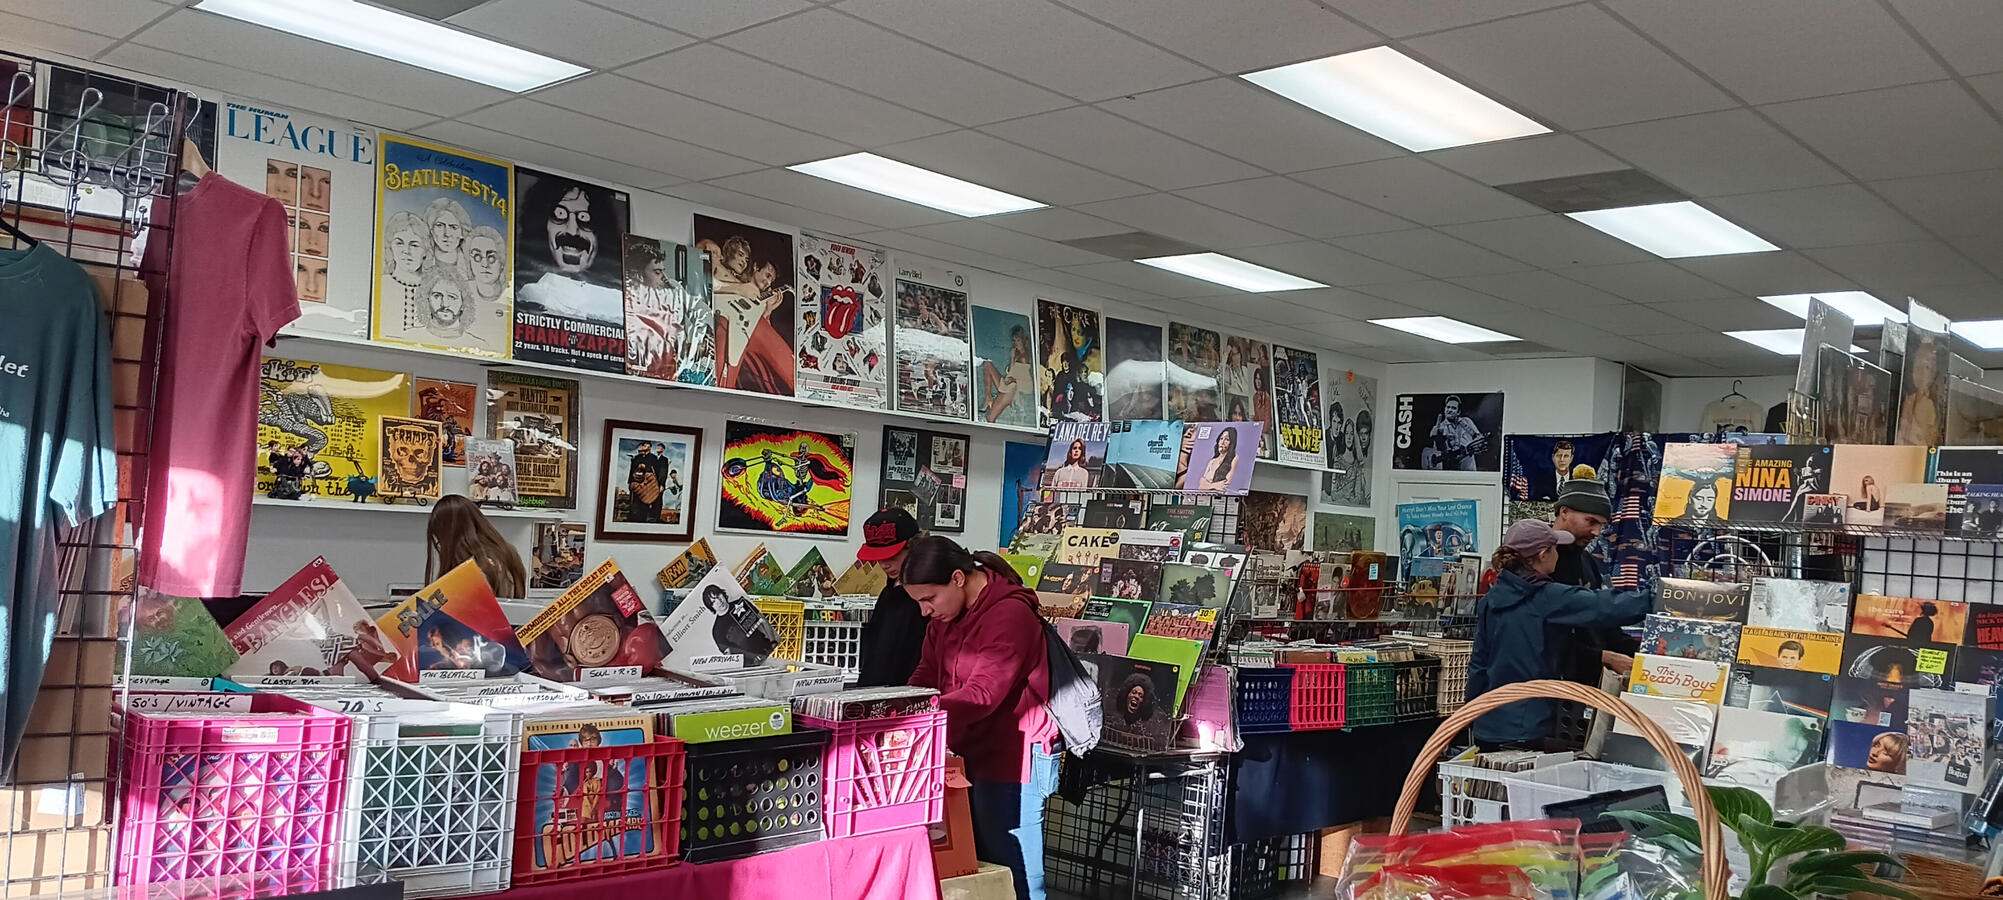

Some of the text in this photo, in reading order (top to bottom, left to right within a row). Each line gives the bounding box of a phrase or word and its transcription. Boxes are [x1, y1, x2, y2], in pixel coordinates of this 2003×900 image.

[226, 102, 289, 119] THE HUMAN
[226, 108, 373, 165] LEAGUE
[516, 312, 561, 329] STRICTLY
[515, 323, 570, 346] FRANK
[520, 388, 548, 403] WANTED
[1397, 396, 1414, 449] CASH
[393, 429, 434, 447] CRAMPS
[1053, 422, 1110, 441] LANA DEL REY
[1755, 460, 1792, 468] AMAZING
[1736, 467, 1791, 489] NINA
[1734, 488, 1791, 502] SIMONE
[1068, 535, 1111, 548] CAKE
[667, 561, 686, 581] RAM
[517, 560, 612, 639] COMMODORES ALL THE GREAT HITS
[1662, 588, 1746, 606] BON JOVI
[244, 574, 330, 653] BANGLES!
[399, 589, 448, 638] POLICE
[689, 606, 707, 625] Smith
[812, 610, 844, 622] ABBA
[692, 655, 740, 666] NEW ARRIVALS
[421, 671, 478, 680] THE BEATLES
[1656, 665, 1675, 676] The
[480, 685, 523, 695] MONKEES
[795, 676, 846, 688] NEW ARRIVALS
[1640, 669, 1717, 698] Beach Boys
[131, 697, 158, 708] 50'S
[338, 699, 383, 713] 70'S
[704, 720, 766, 740] weezer
